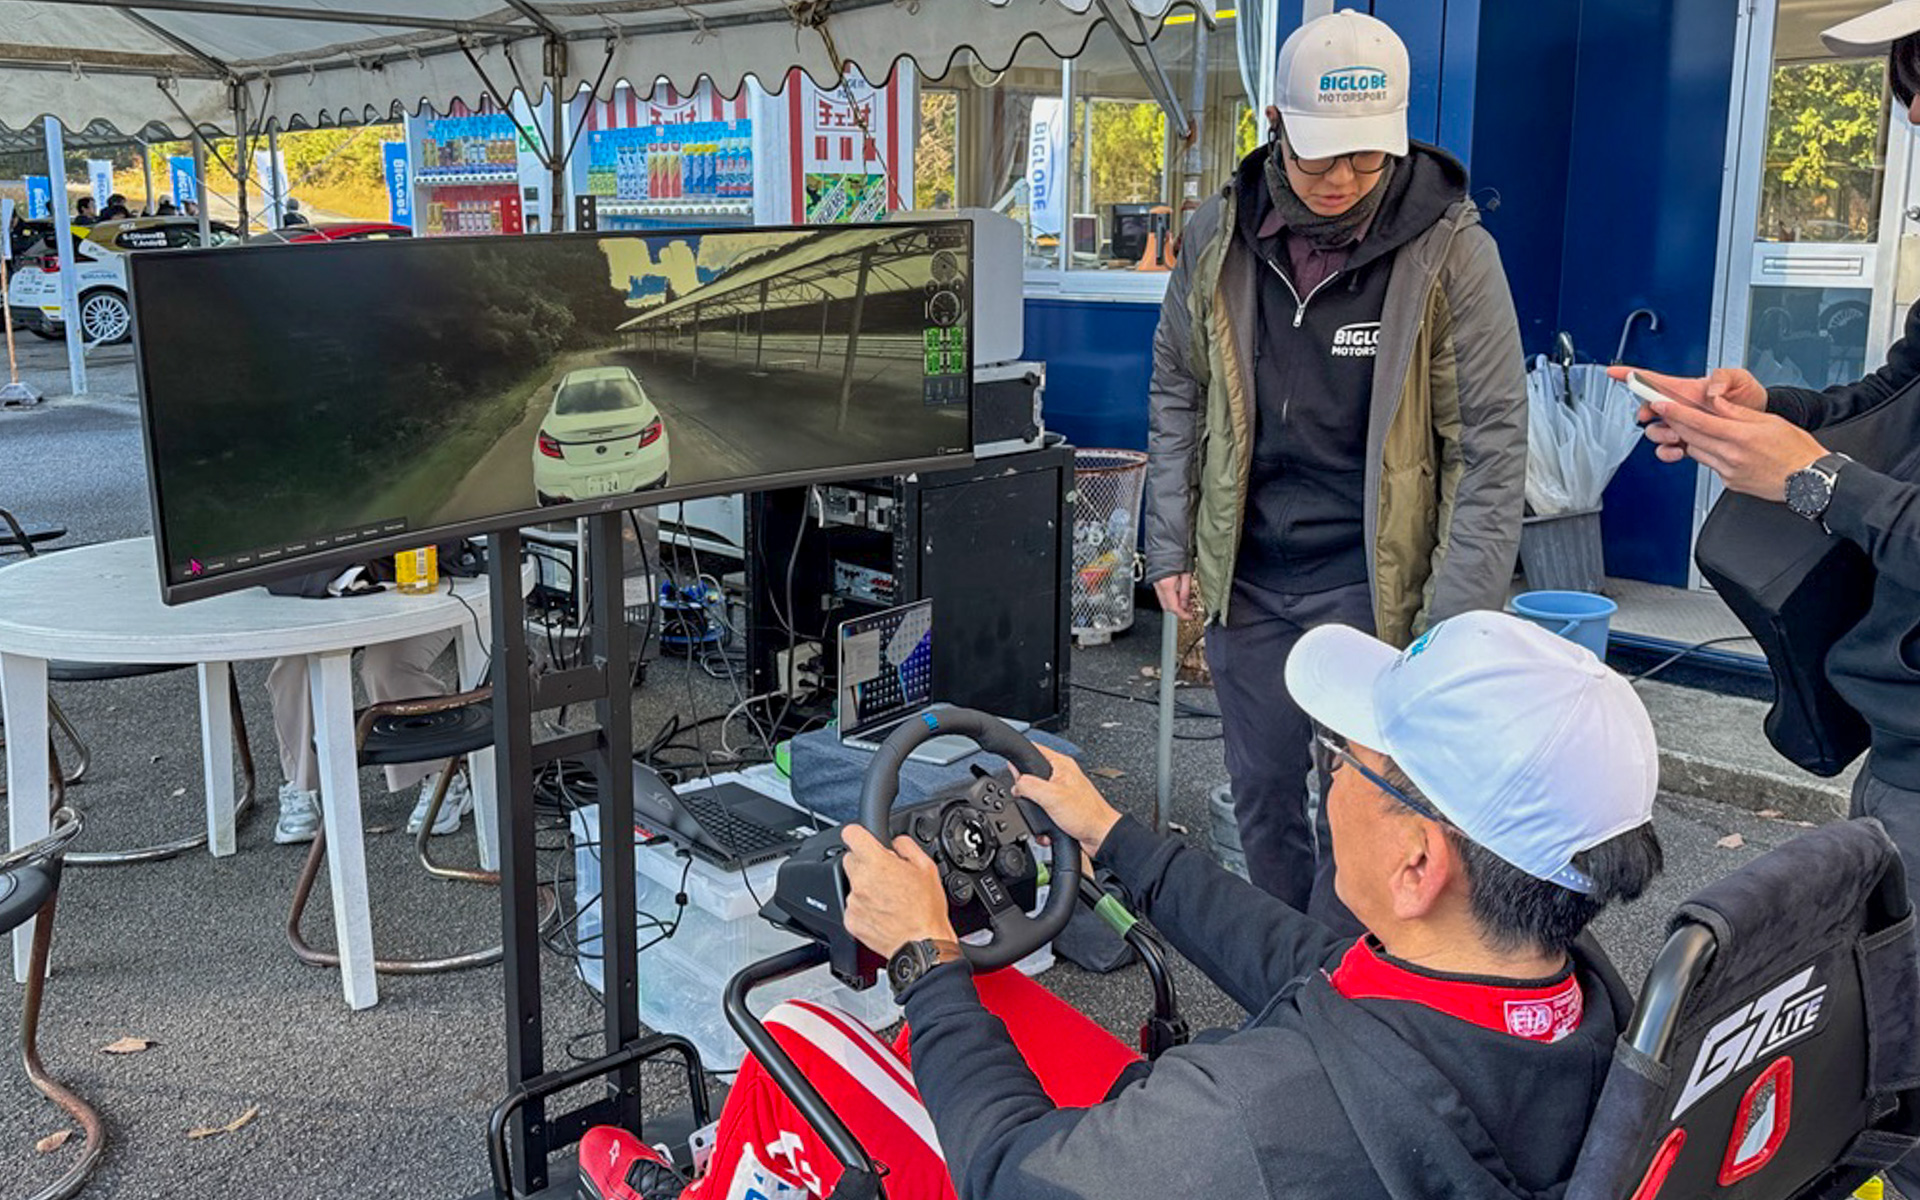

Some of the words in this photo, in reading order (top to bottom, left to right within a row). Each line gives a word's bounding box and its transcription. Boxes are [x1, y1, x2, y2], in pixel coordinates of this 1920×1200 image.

[1319, 74, 1387, 91] BIGLOBE
[1317, 91, 1387, 103] MOTORSPORT
[1333, 329, 1380, 345] BIGLO
[1331, 346, 1377, 357] MOTORS
[1513, 1009, 1549, 1032] FIA
[1669, 964, 1815, 1122] GT
[1767, 994, 1825, 1045] LITE
